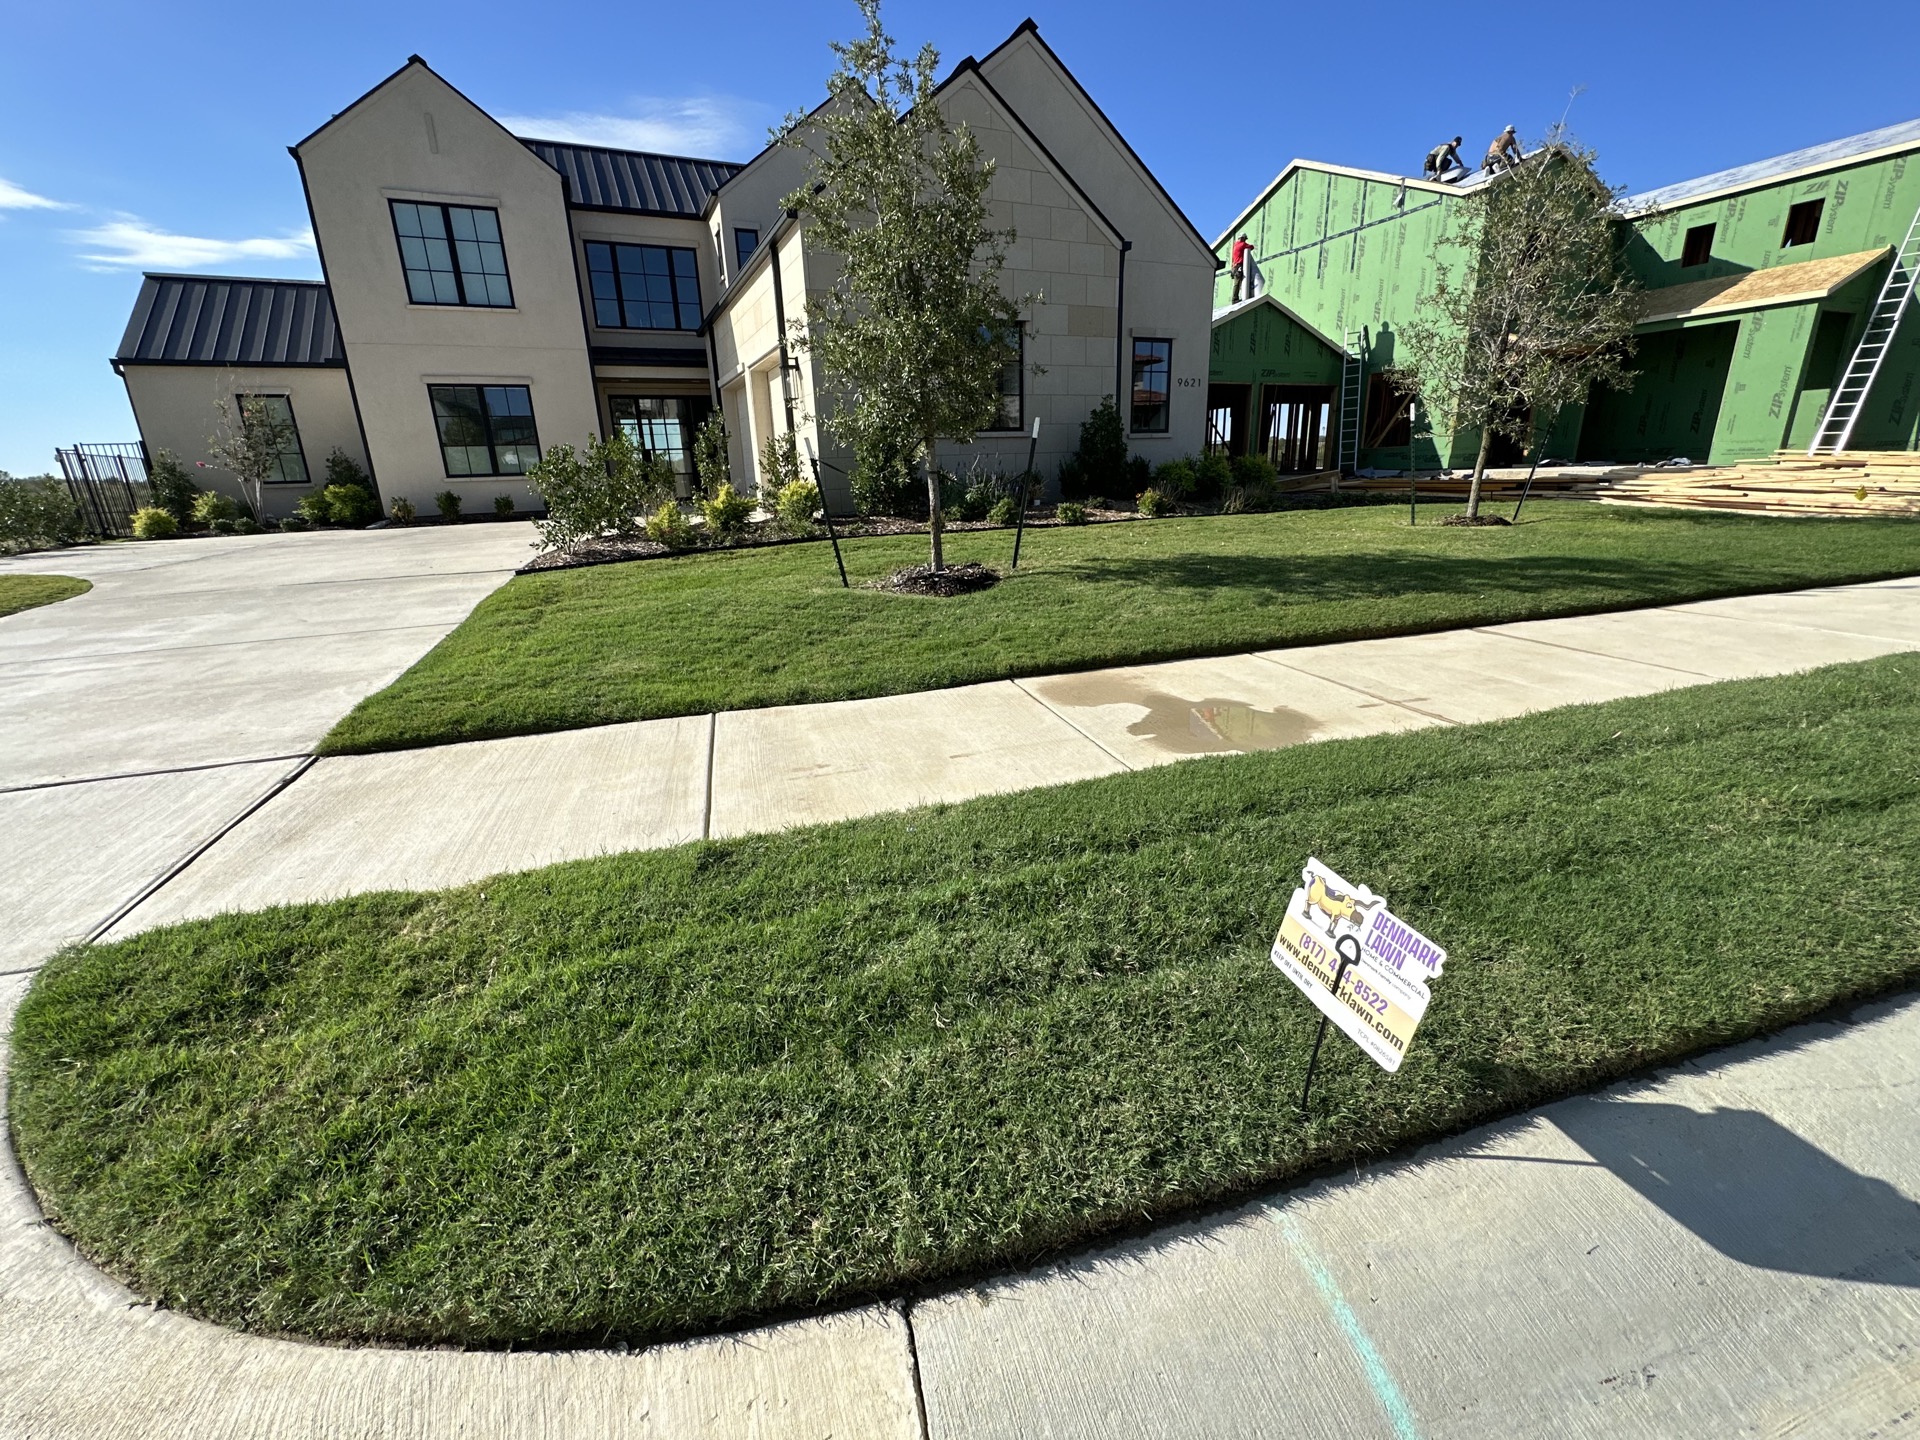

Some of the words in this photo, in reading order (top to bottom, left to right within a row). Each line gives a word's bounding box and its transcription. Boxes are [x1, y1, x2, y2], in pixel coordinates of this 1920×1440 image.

[1177, 378, 1201, 387] 9621
[1364, 929, 1407, 971] LAWN
[1372, 911, 1442, 972] DENMARK
[1299, 932, 1327, 965] (817)
[1328, 957, 1388, 1016] 44-8522
[1384, 965, 1425, 1000] COMMERCIAL
